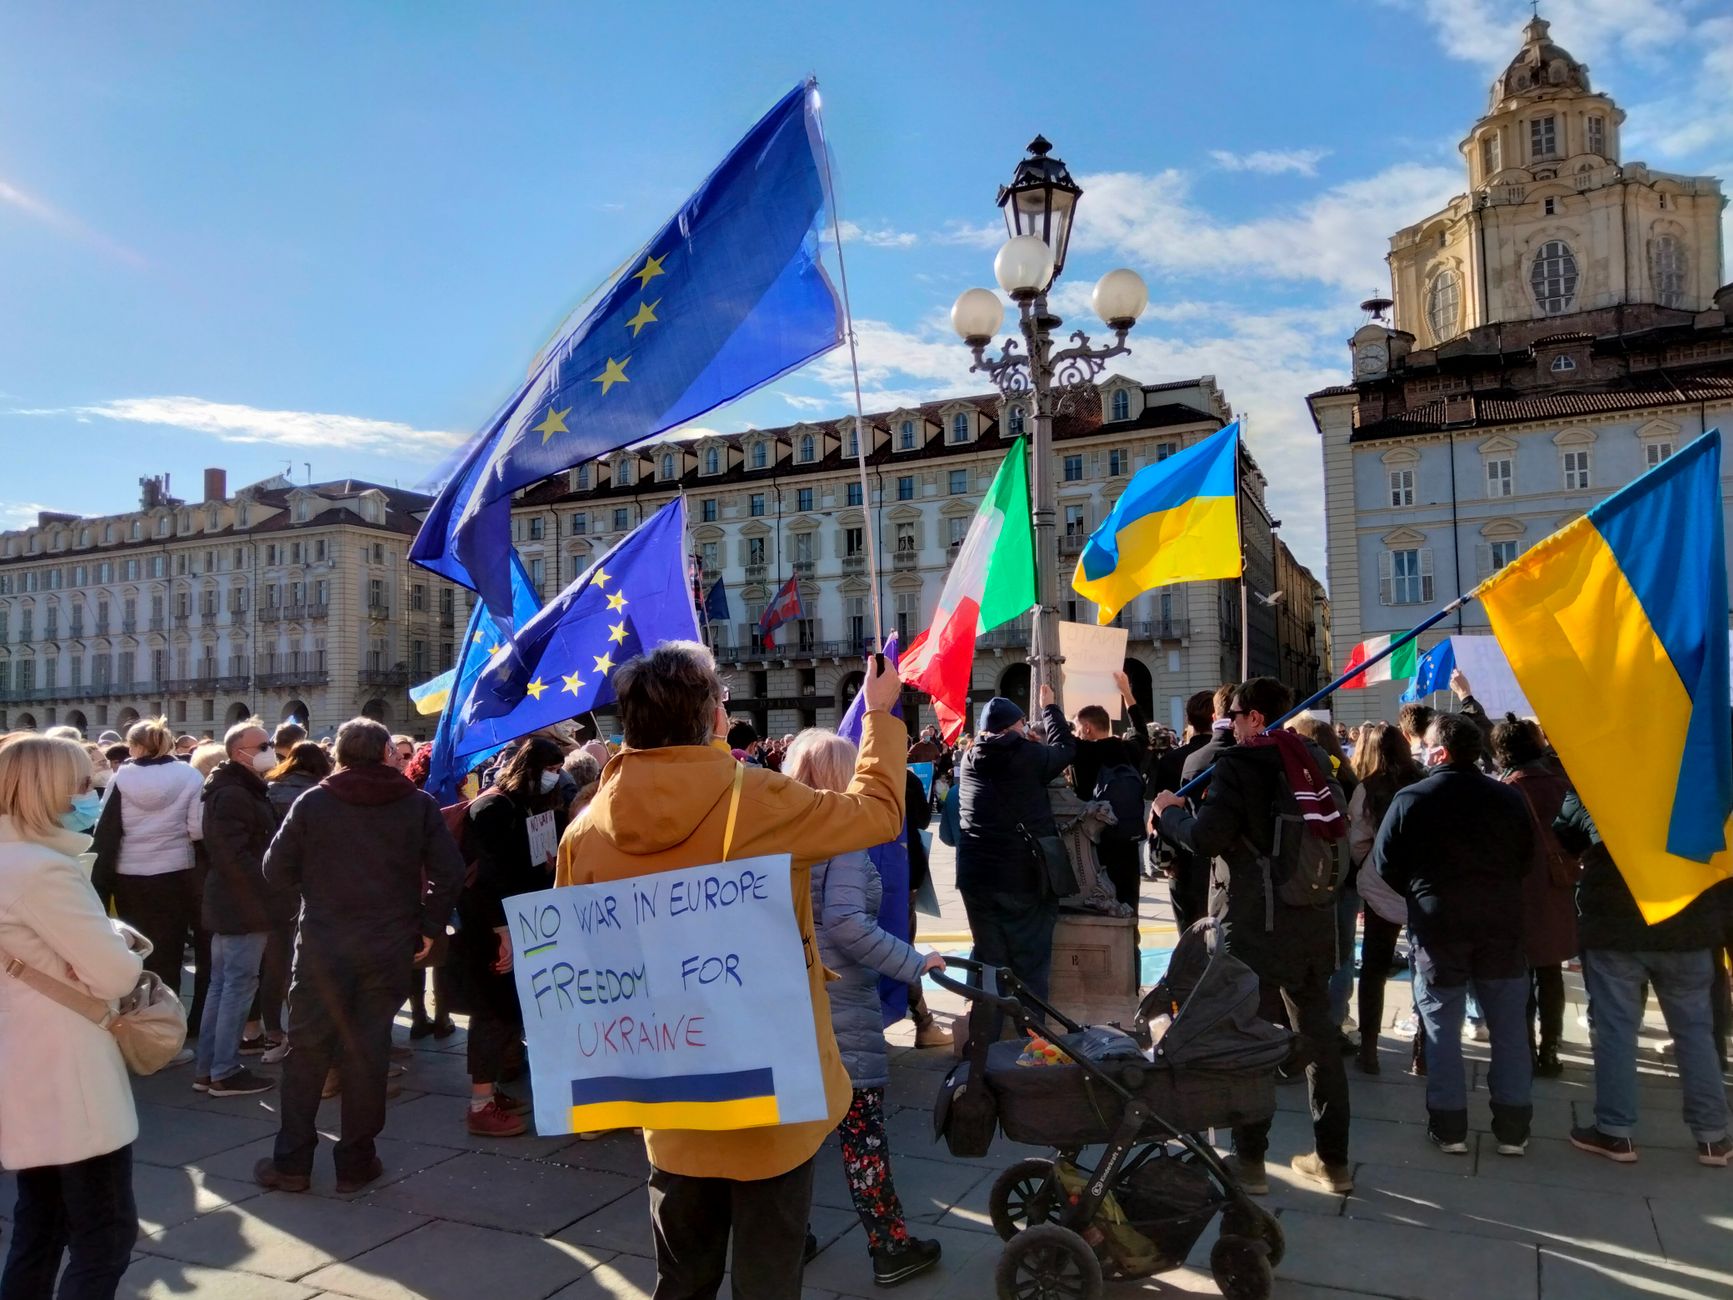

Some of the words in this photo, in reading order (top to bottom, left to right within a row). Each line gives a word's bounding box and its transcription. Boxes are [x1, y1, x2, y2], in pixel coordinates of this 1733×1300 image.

[518, 904, 561, 944] NO
[573, 895, 622, 935] WAR
[632, 882, 659, 926] IN
[670, 870, 769, 917] EUROPE
[531, 961, 650, 1019] FREEDOM
[681, 953, 743, 991] FOR
[577, 1012, 707, 1058] UKRAINE
